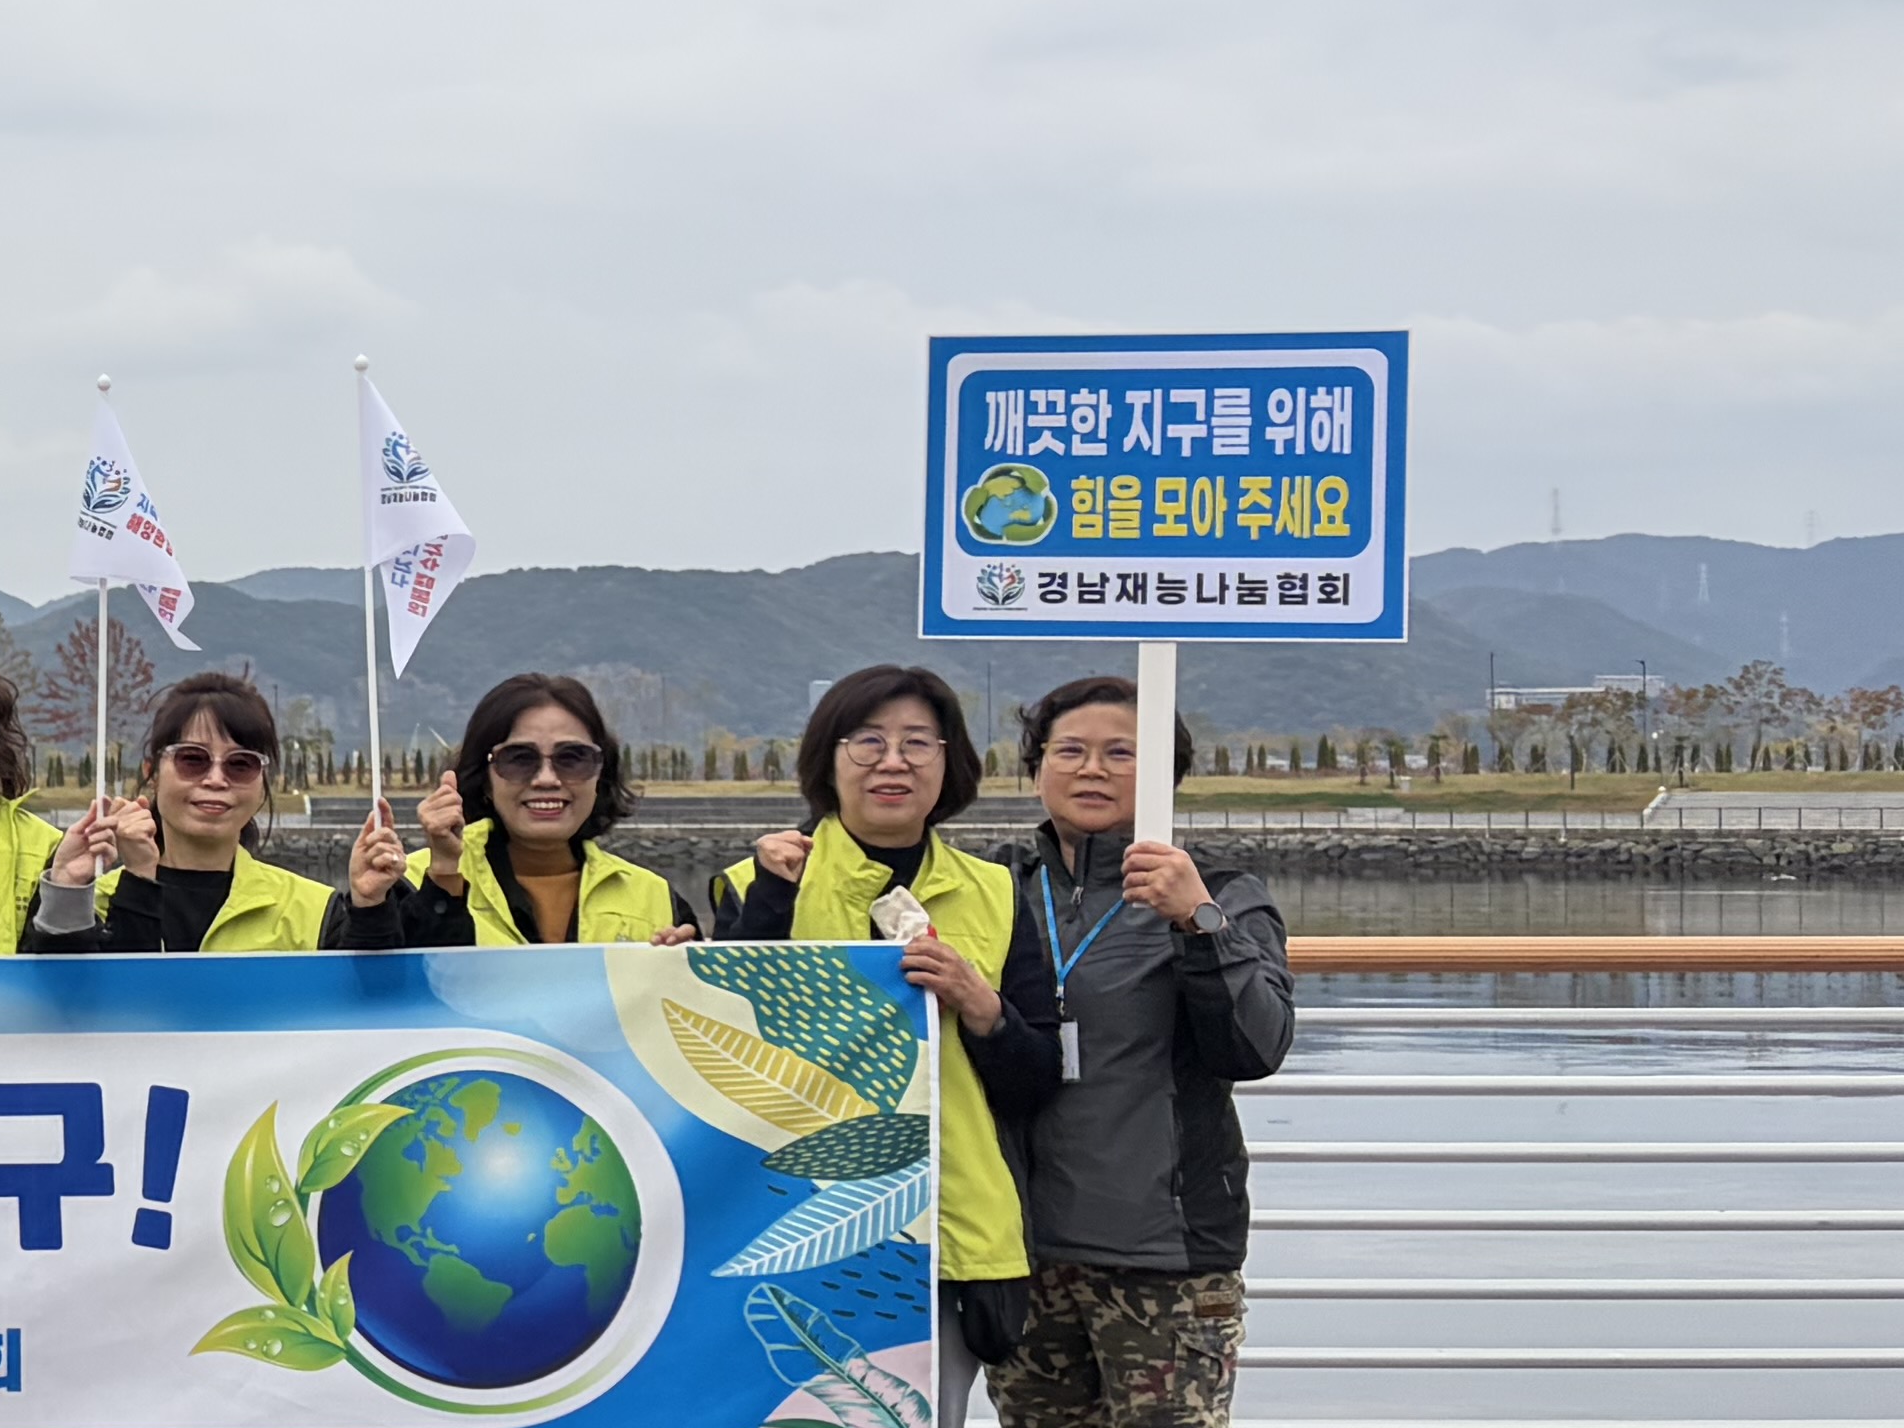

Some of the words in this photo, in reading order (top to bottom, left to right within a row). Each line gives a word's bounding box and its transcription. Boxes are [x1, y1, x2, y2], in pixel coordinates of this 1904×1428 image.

[983, 387, 1112, 457] 깨끗한
[1122, 387, 1252, 457] 지구를
[1265, 385, 1353, 456] 위해
[1070, 475, 1143, 539] 힘을
[1153, 475, 1227, 539] 모아
[1237, 475, 1350, 540] 주세요
[1037, 570, 1351, 607] 경남재능나눔협회
